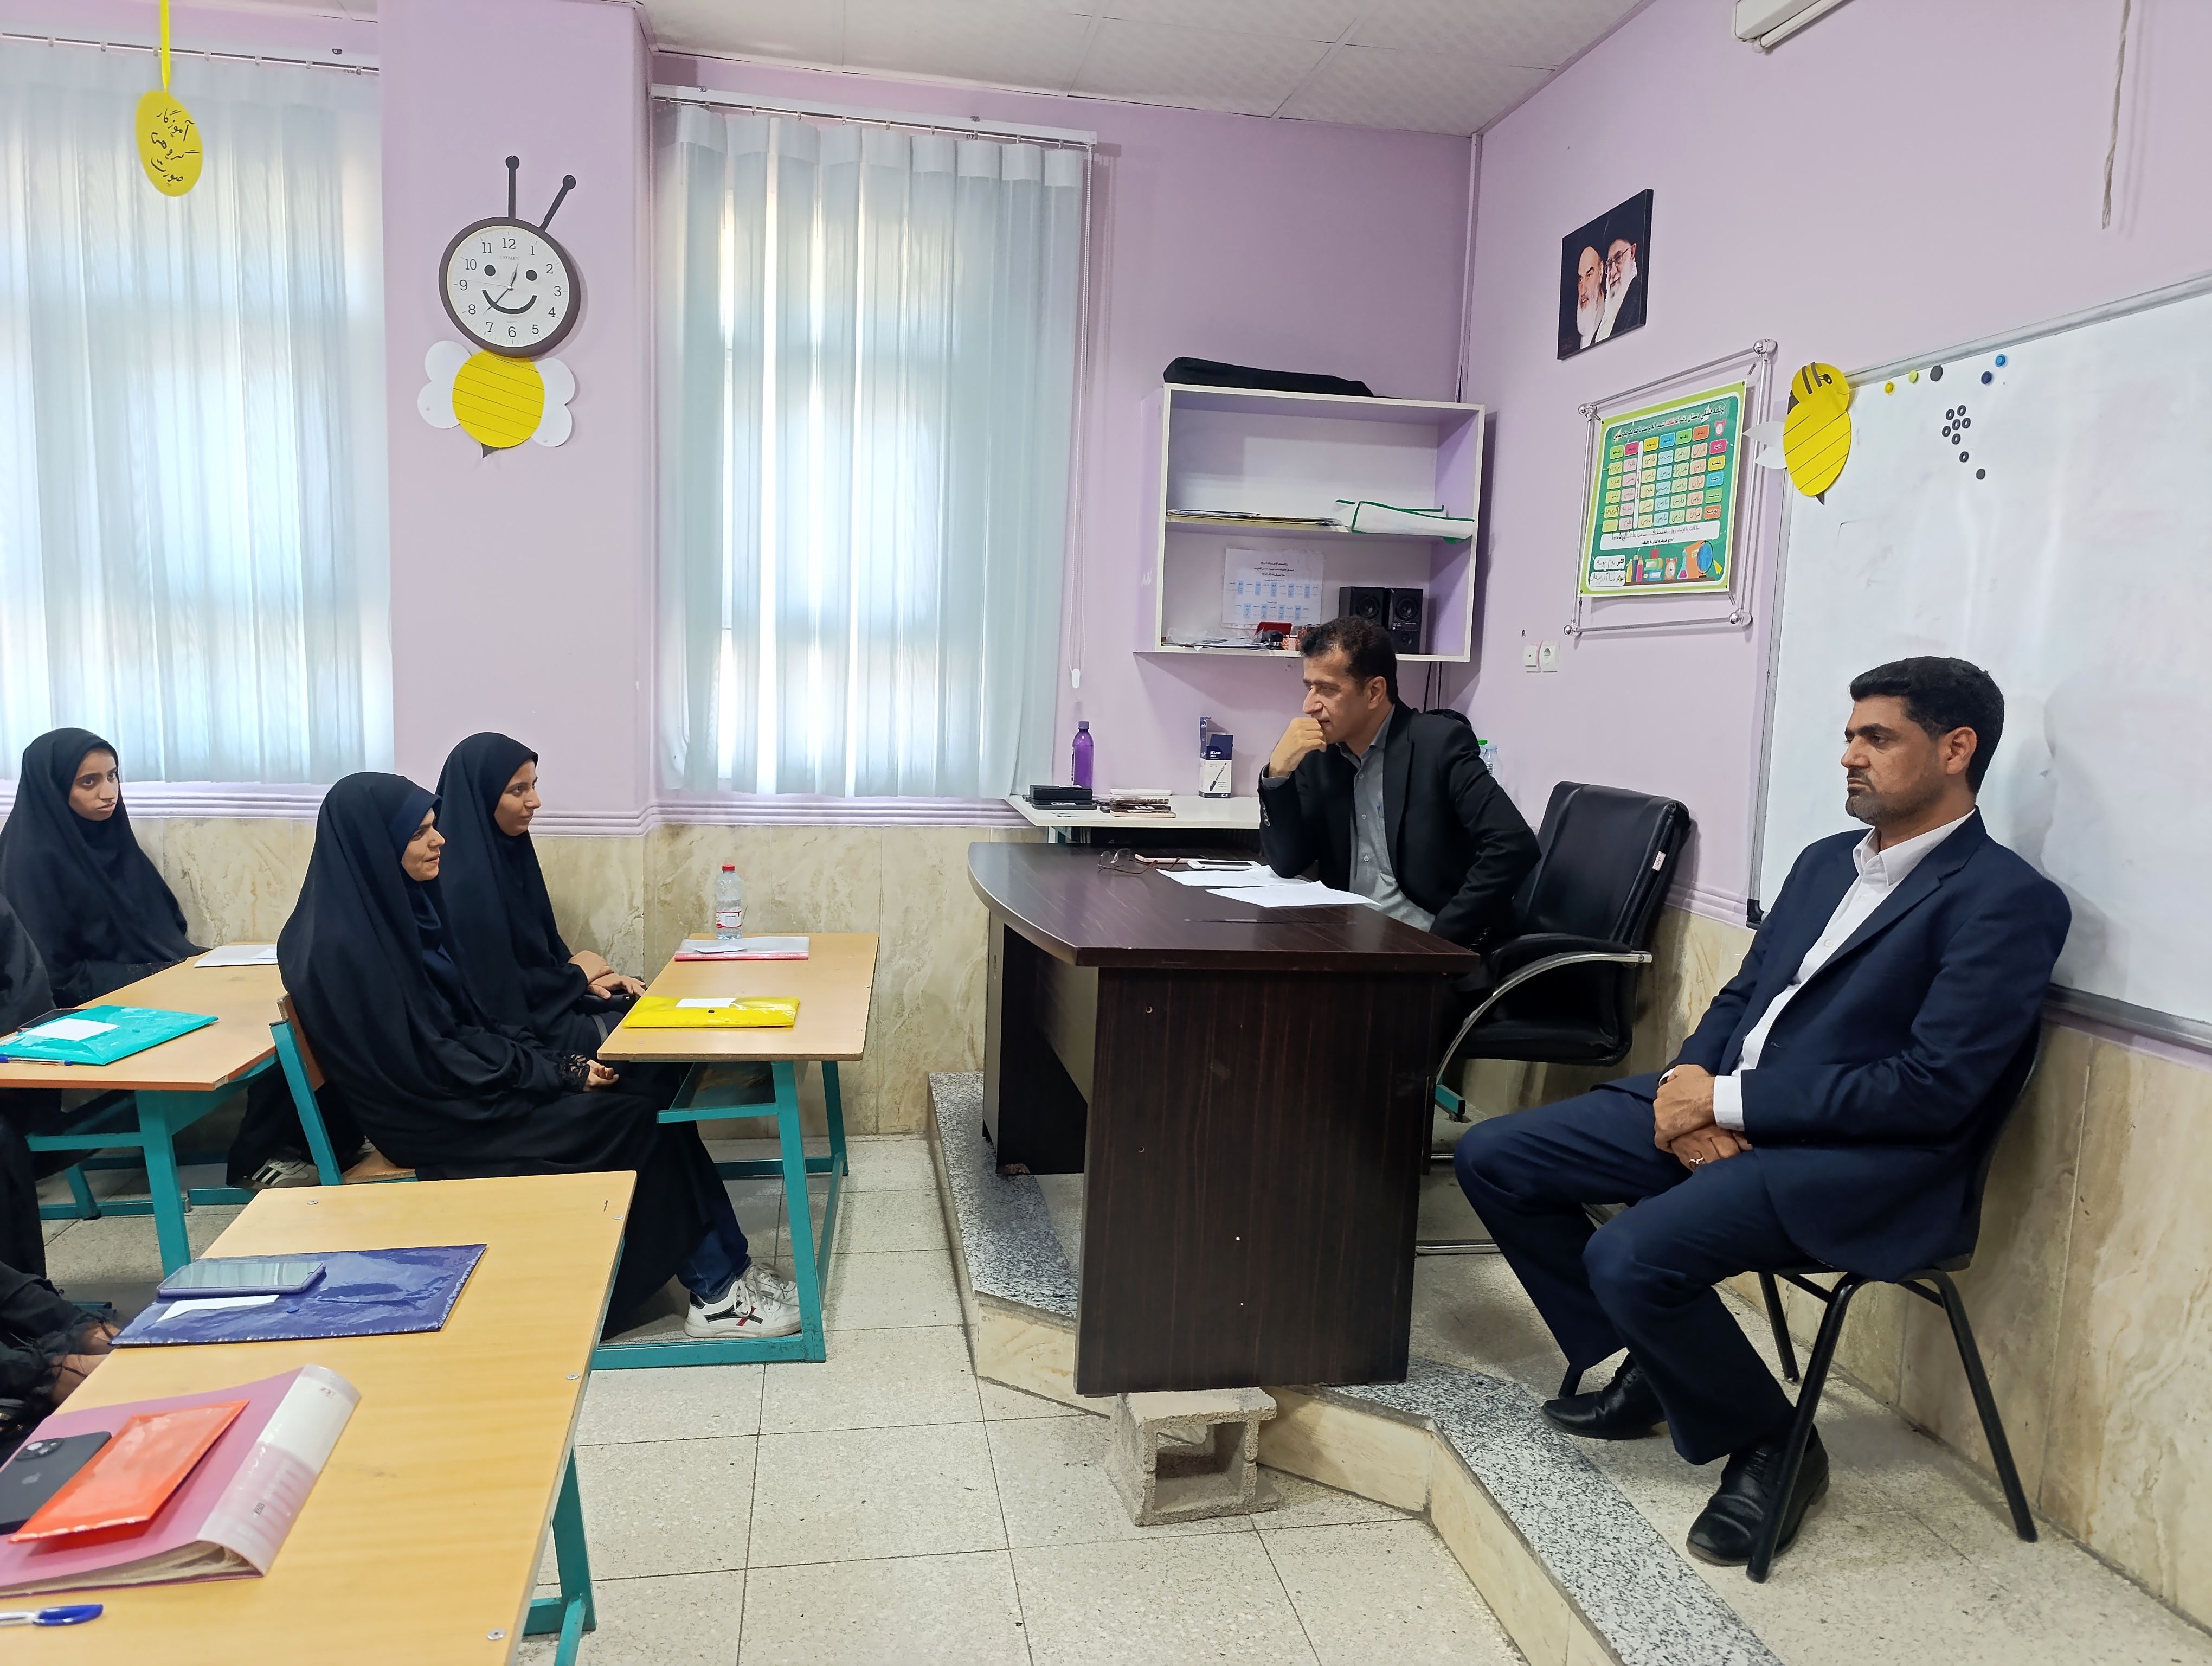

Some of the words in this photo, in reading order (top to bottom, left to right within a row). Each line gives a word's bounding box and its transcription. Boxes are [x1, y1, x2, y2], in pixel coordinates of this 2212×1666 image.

[482, 242, 492, 254] 11
[503, 238, 516, 249] 12
[530, 245, 535, 255] 1
[465, 258, 477, 271] 10
[546, 264, 554, 274] 2
[459, 279, 468, 291] 9
[554, 285, 562, 297] 3
[468, 304, 476, 315] 8
[548, 307, 556, 318] 4
[486, 322, 494, 332] 7
[508, 326, 516, 337] 6
[532, 324, 539, 334] 5
[1616, 558, 1624, 566] کلاس
